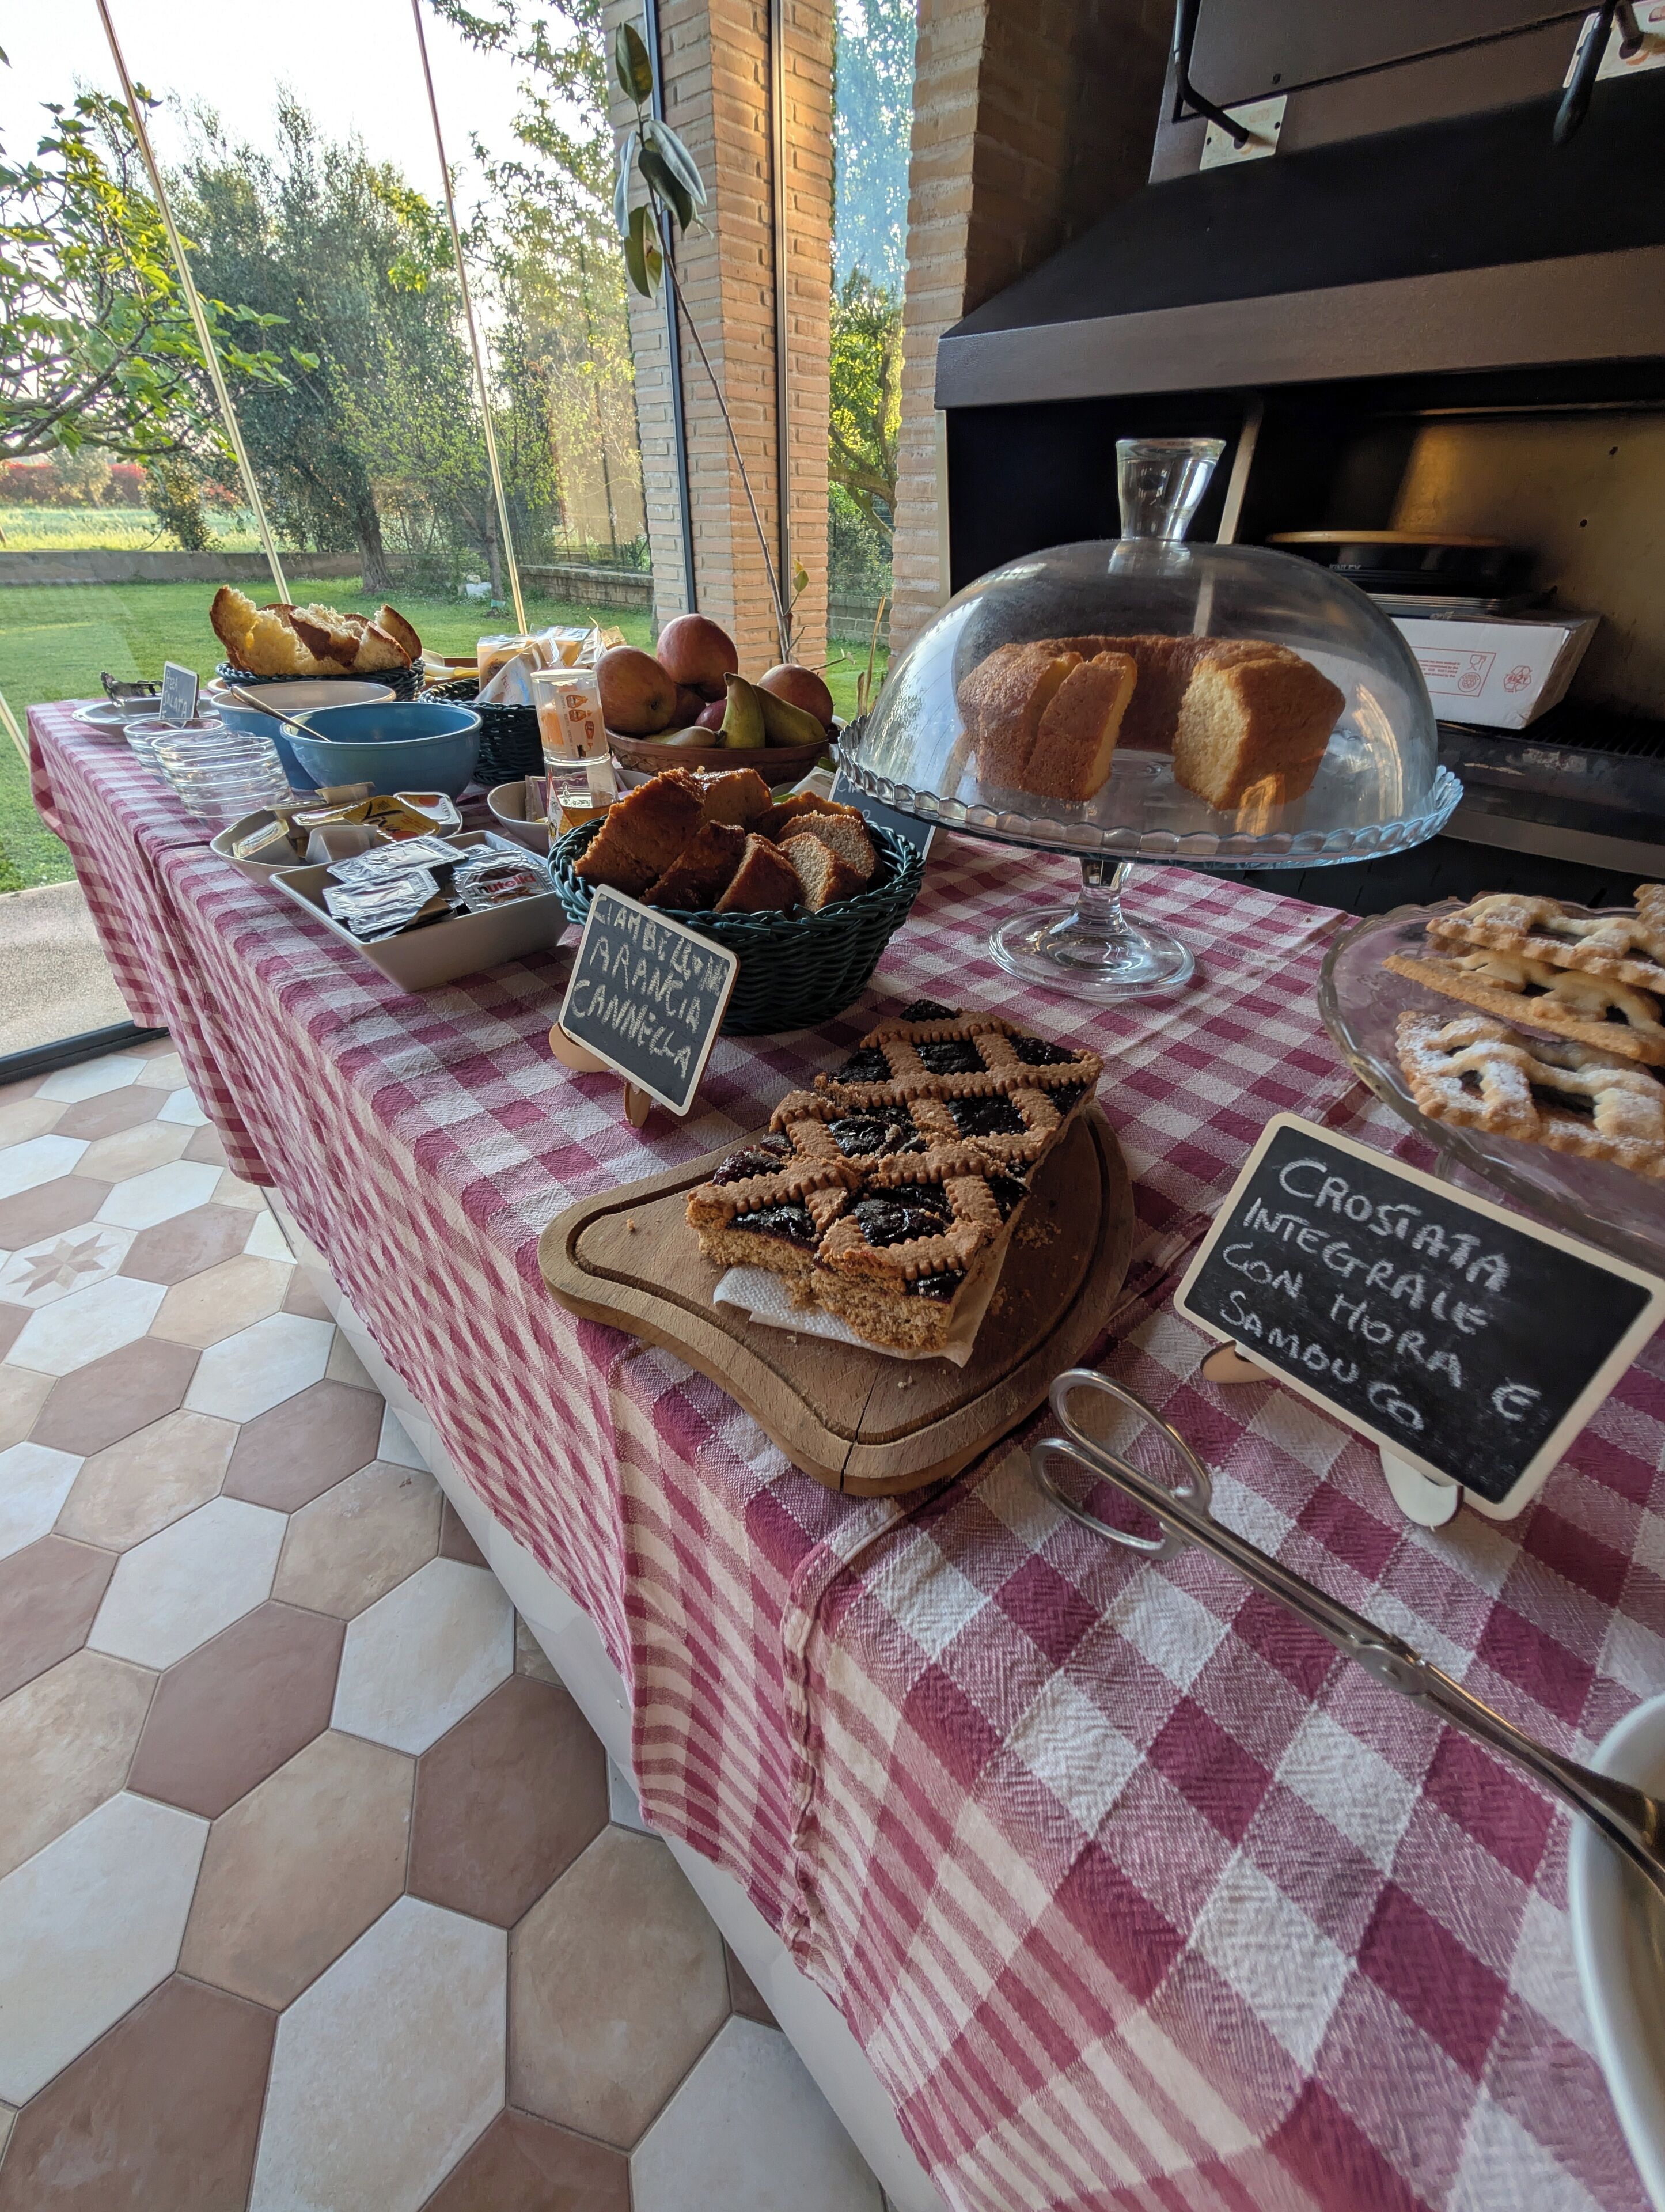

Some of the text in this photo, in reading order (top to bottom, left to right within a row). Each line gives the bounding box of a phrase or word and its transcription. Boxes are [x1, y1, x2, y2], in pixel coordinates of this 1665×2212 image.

[477, 873, 536, 893] nutella
[1222, 1241, 1304, 1300] CON
[1490, 1378, 1542, 1421] E
[1242, 1196, 1488, 1334] INTEGRALE
